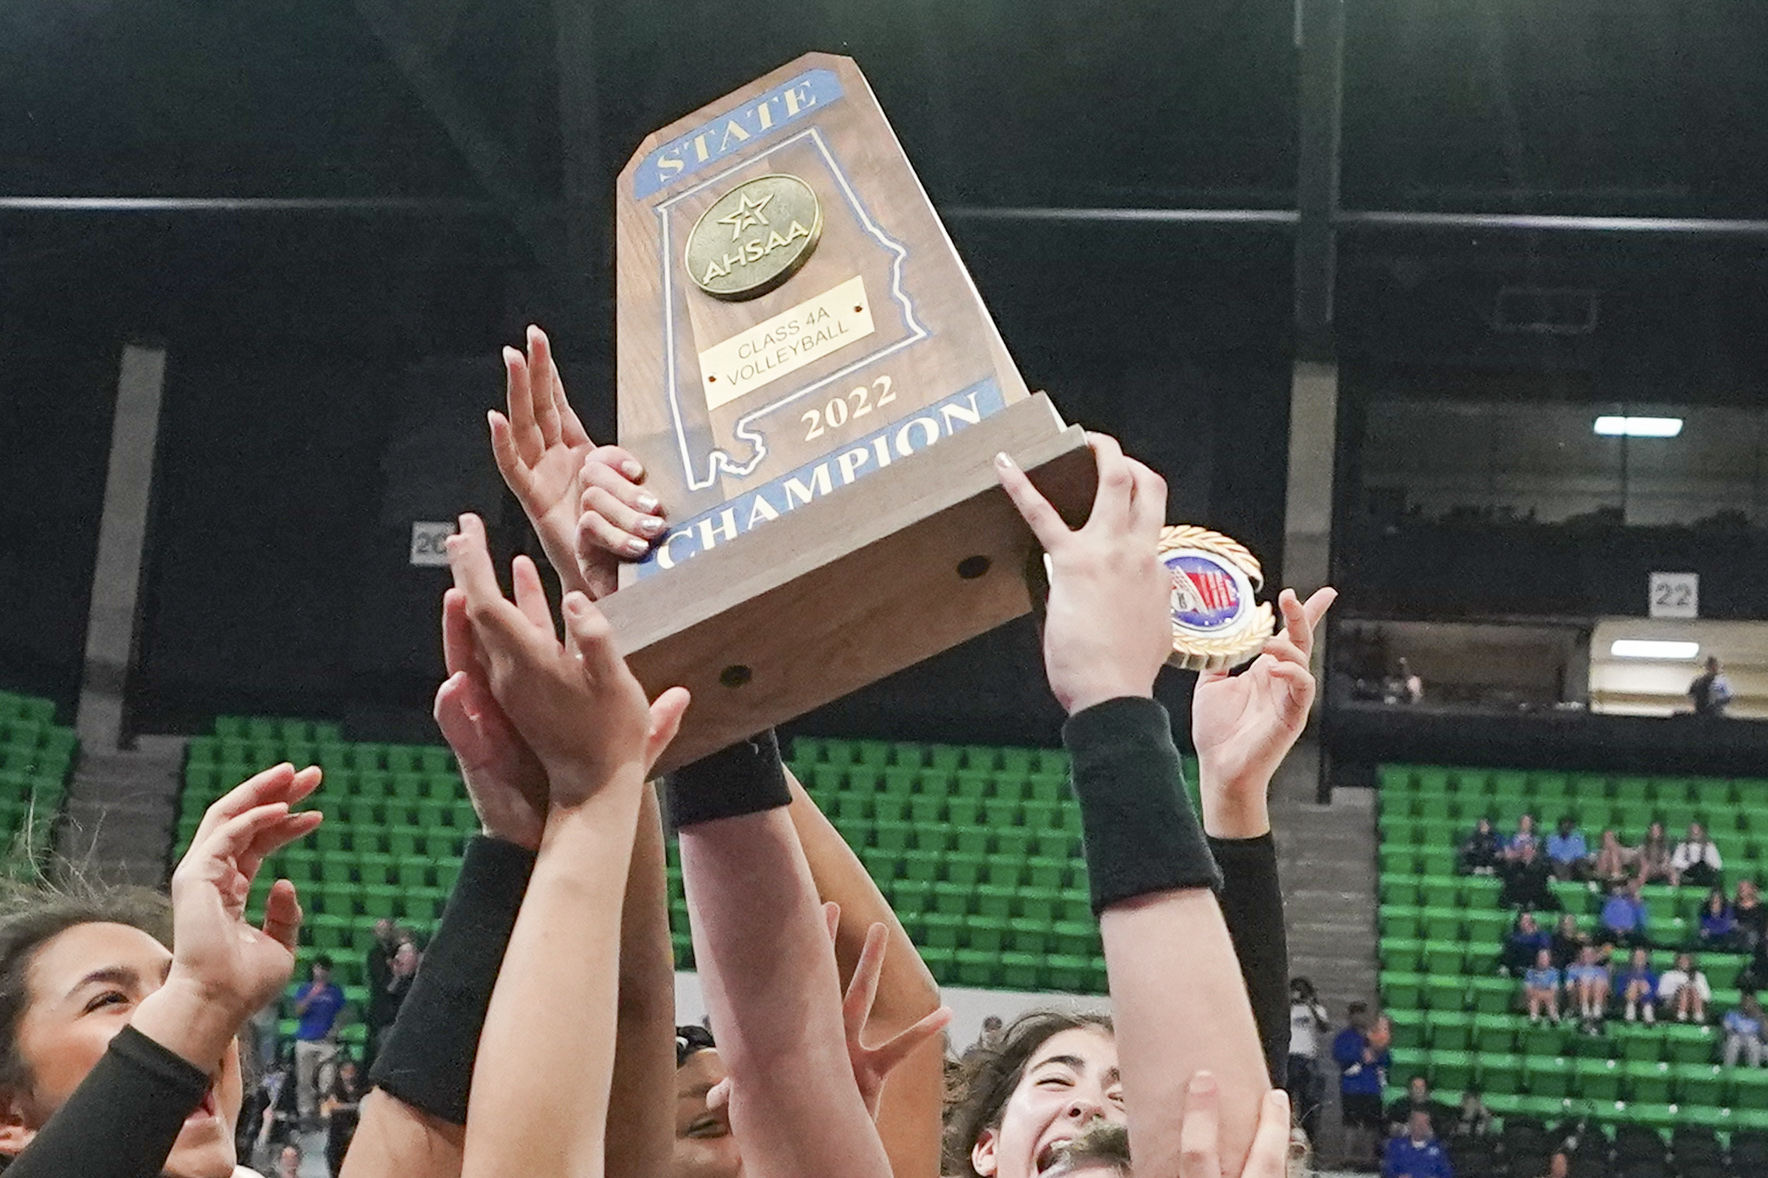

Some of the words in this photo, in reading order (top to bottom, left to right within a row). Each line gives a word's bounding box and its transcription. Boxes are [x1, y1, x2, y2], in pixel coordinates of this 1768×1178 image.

[656, 79, 818, 184] STATE
[702, 219, 809, 285] AHSAA
[726, 320, 849, 386] VOLLEYBALL
[737, 319, 802, 361] CLASS
[805, 306, 831, 326] 4A
[800, 375, 898, 443] 2022
[656, 392, 984, 571] CHAMPION
[1654, 583, 1692, 606] 22
